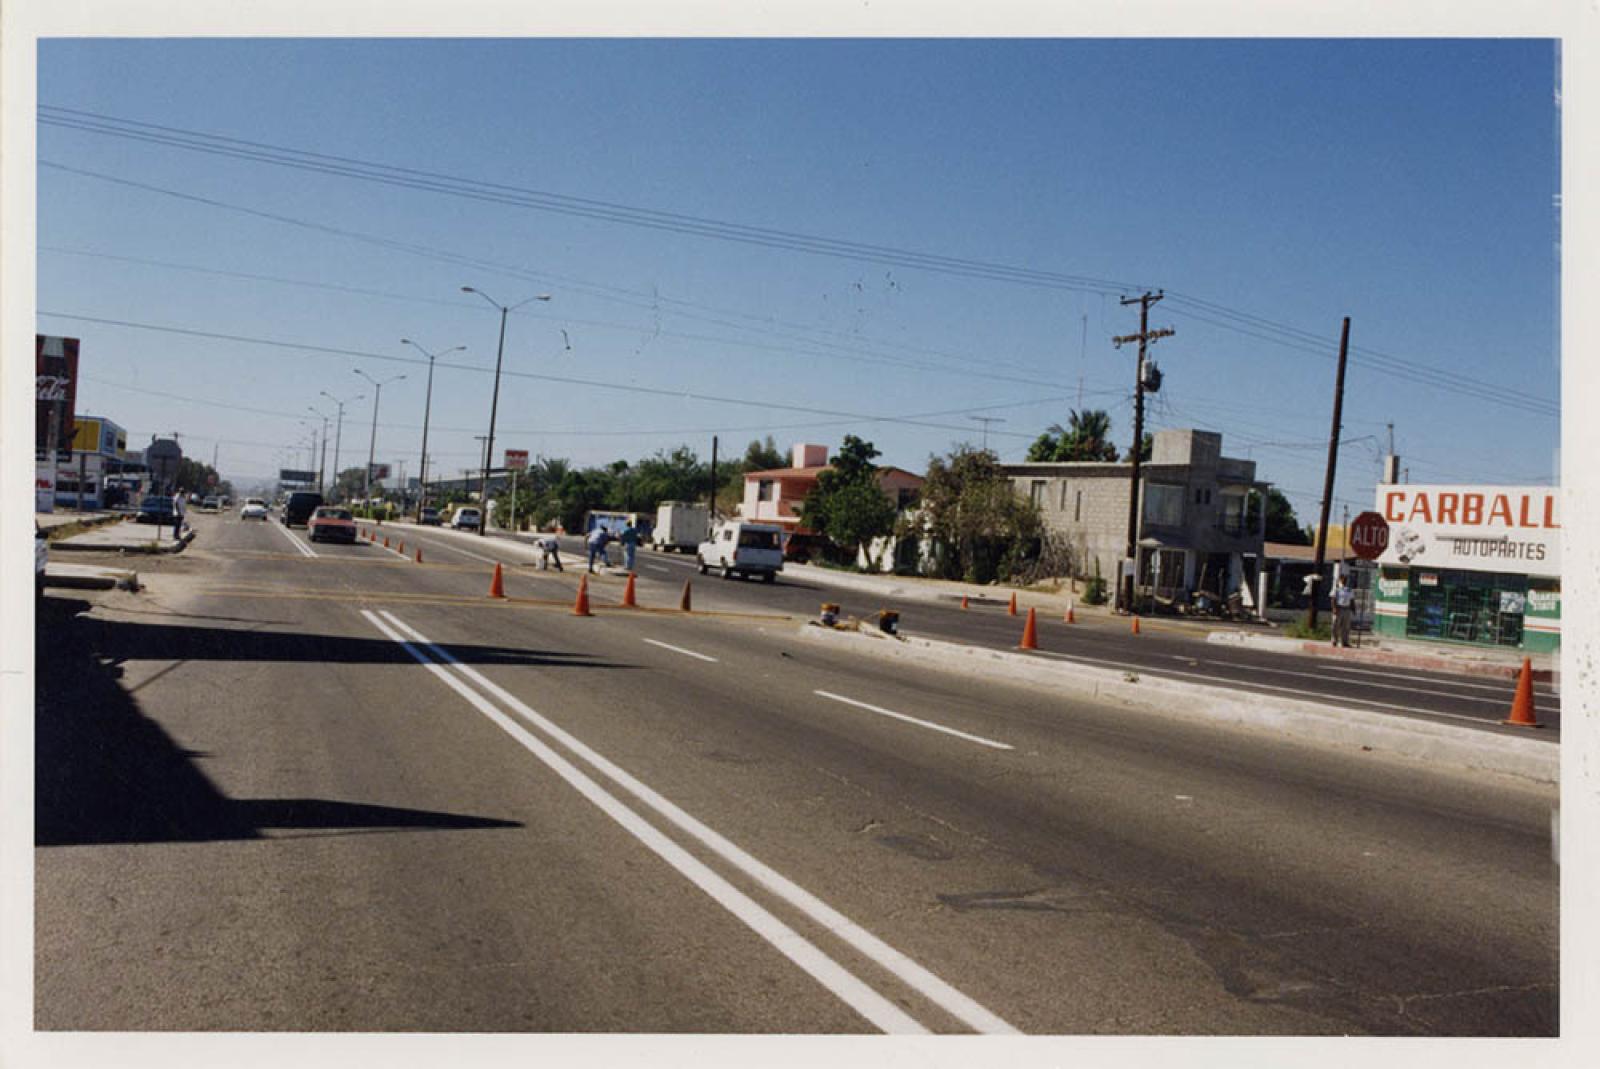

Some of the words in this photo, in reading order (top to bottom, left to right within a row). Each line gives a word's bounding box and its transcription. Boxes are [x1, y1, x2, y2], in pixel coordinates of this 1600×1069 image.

[1385, 491, 1561, 529] CARBALL
[1352, 524, 1387, 547] ALTO
[1453, 538, 1546, 561] AUTOPARTES
